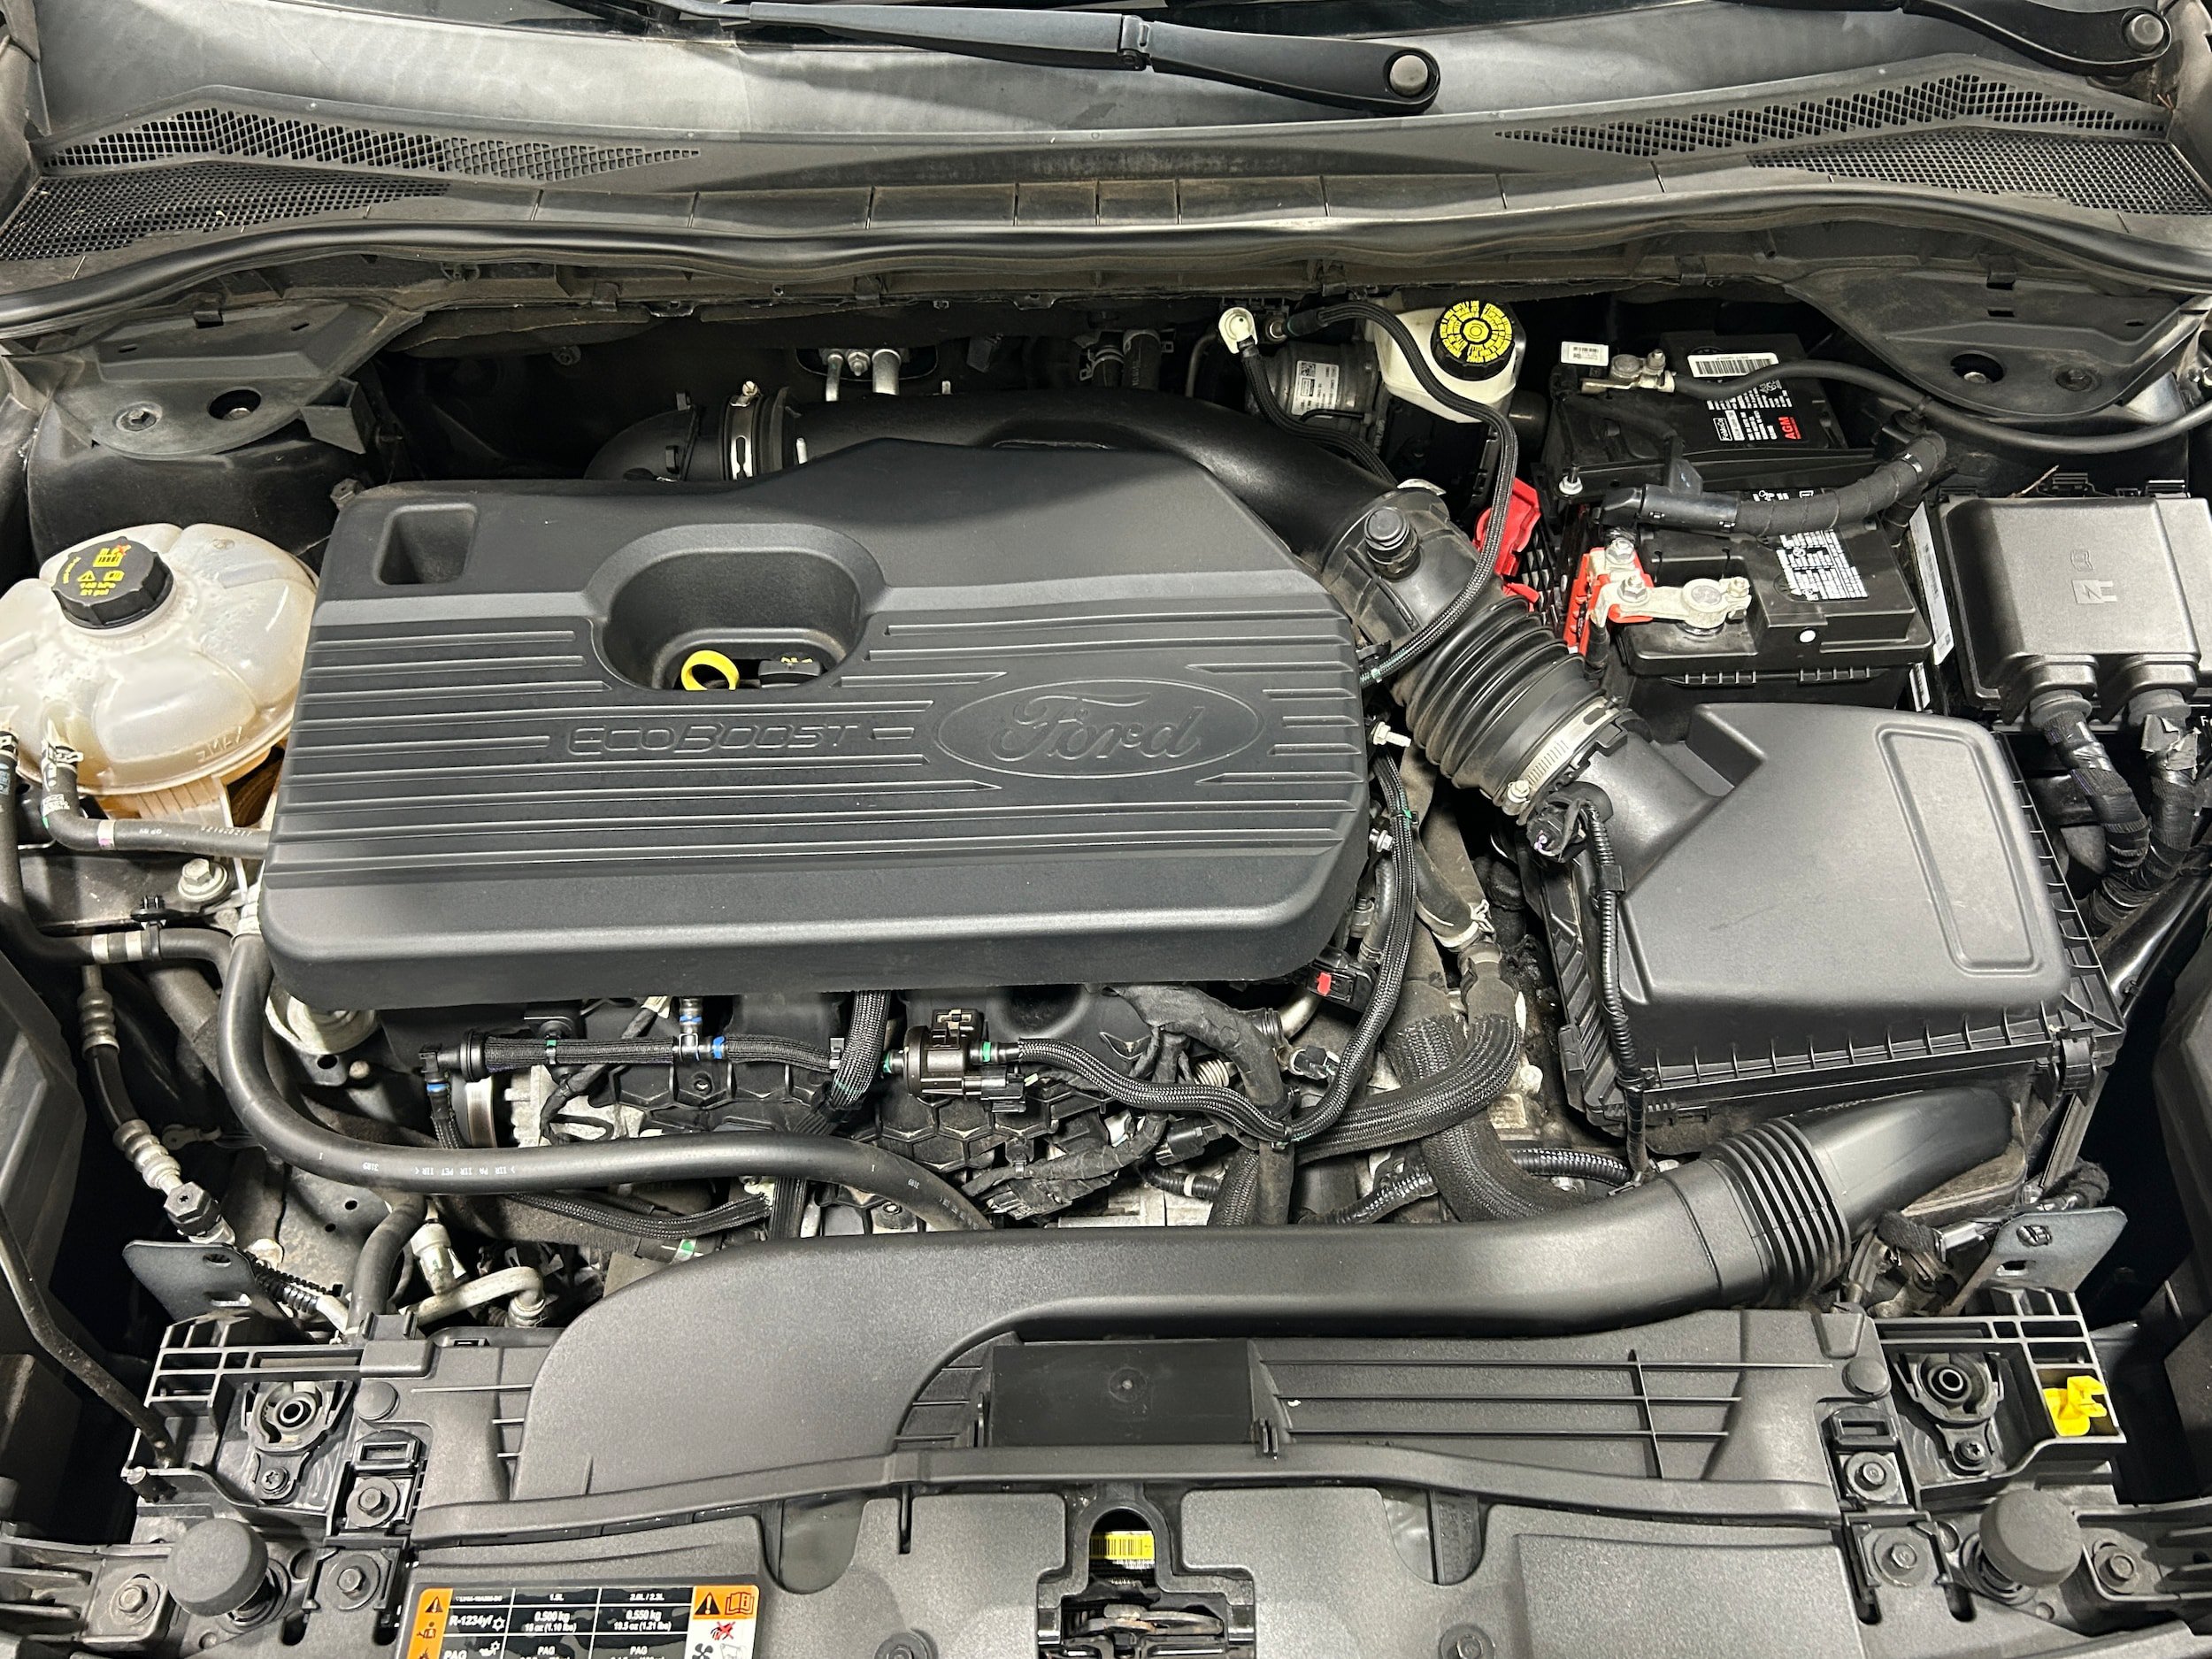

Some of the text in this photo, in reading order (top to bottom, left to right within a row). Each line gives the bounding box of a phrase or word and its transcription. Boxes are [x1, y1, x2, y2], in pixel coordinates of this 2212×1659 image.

[1778, 416, 1797, 440] AGM
[989, 691, 1206, 763] Ford
[449, 1615, 492, 1628] R-1234yf
[534, 1610, 571, 1624] 0.500 kg
[625, 1609, 662, 1622] 0.550 kg
[443, 1648, 468, 1659] PAG
[537, 1646, 556, 1655] PAG
[629, 1646, 648, 1655] PAG
